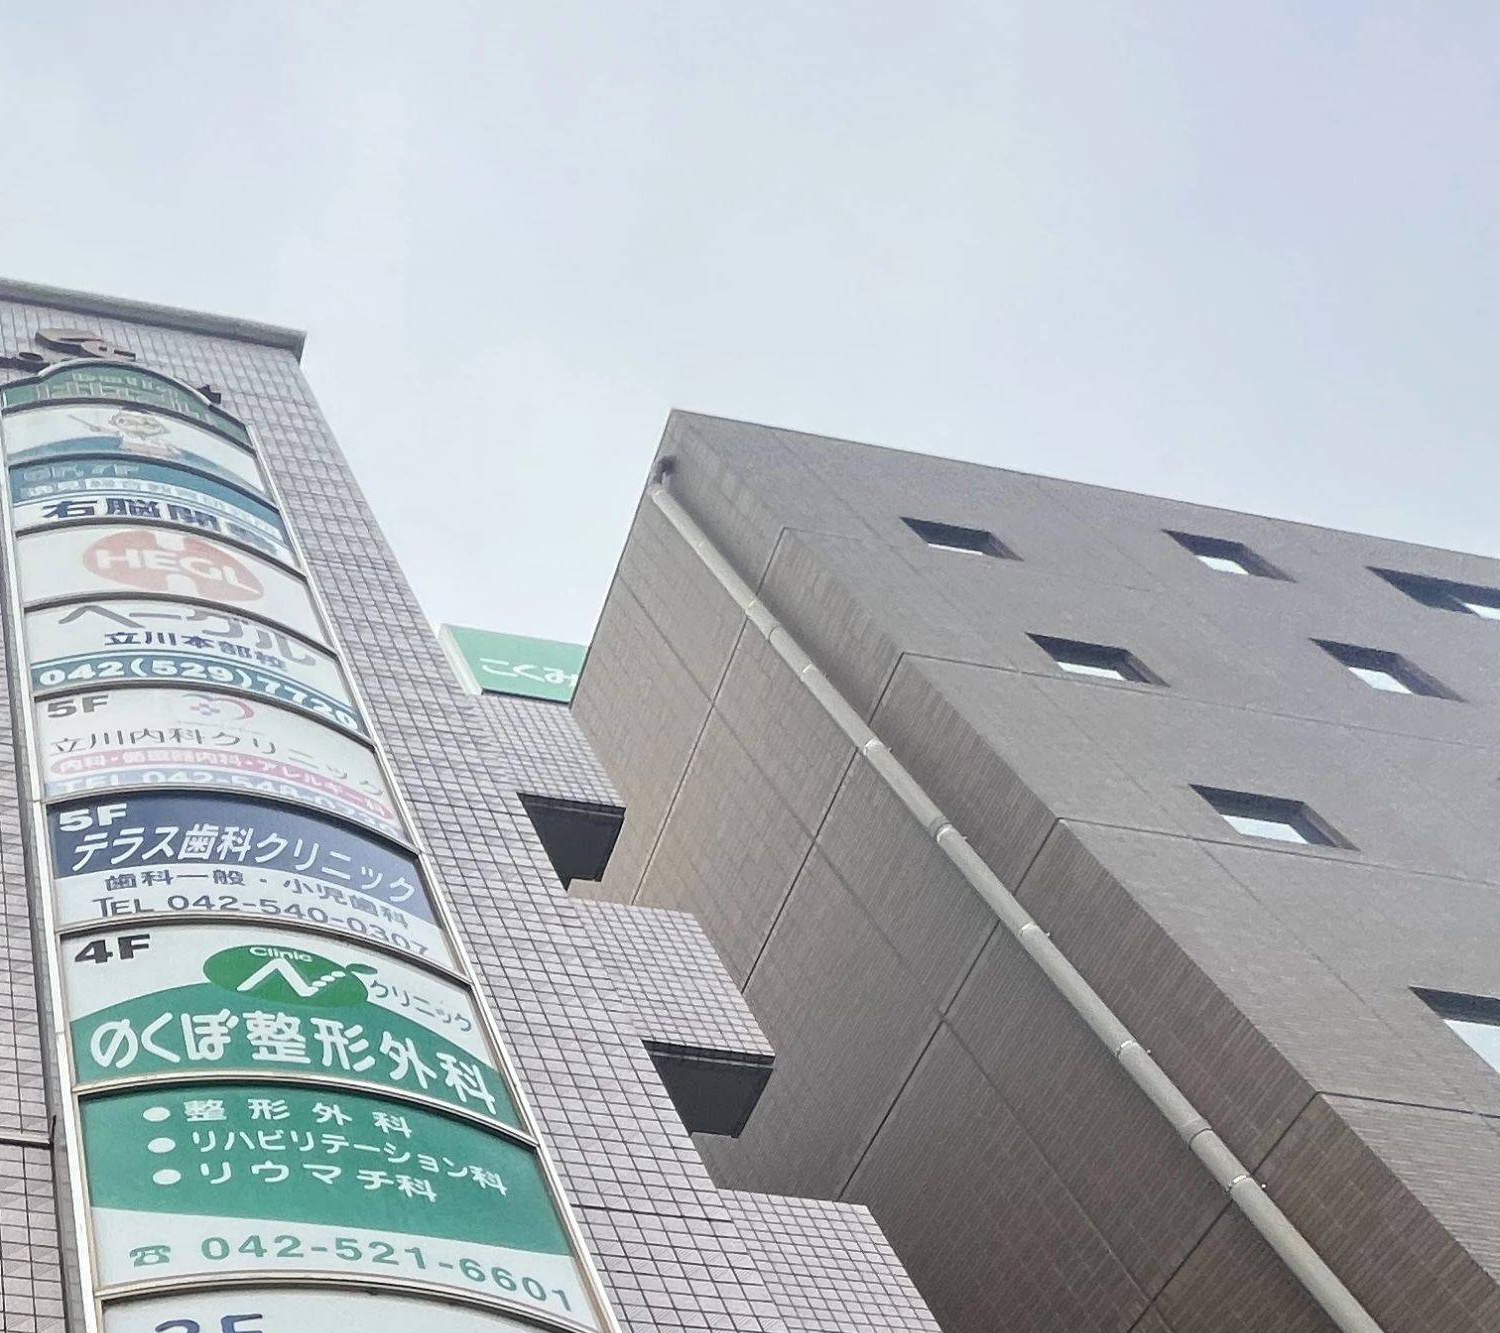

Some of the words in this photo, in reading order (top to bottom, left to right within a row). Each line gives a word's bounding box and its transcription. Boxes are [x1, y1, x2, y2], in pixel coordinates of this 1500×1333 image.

[104, 631, 288, 673] 立川本部校
[39, 658, 360, 730] 042(529)7720
[47, 695, 109, 718] 5F
[49, 728, 386, 797] 立川内科クリニック
[59, 803, 128, 833] 5F
[72, 824, 416, 903] テラス歯科クリニック
[74, 934, 151, 965] 4F
[93, 896, 154, 918] TEL
[167, 893, 430, 957] 042-540-0307
[249, 946, 313, 963] Clinic
[369, 980, 474, 1034] クリニック
[90, 1008, 495, 1114] のくぼ整形外科
[184, 1098, 413, 1139] 整形外科
[193, 1130, 508, 1197] リハビリテーション科
[200, 1160, 437, 1203] リウマチ科
[201, 1234, 573, 1312] 042-521-6601
